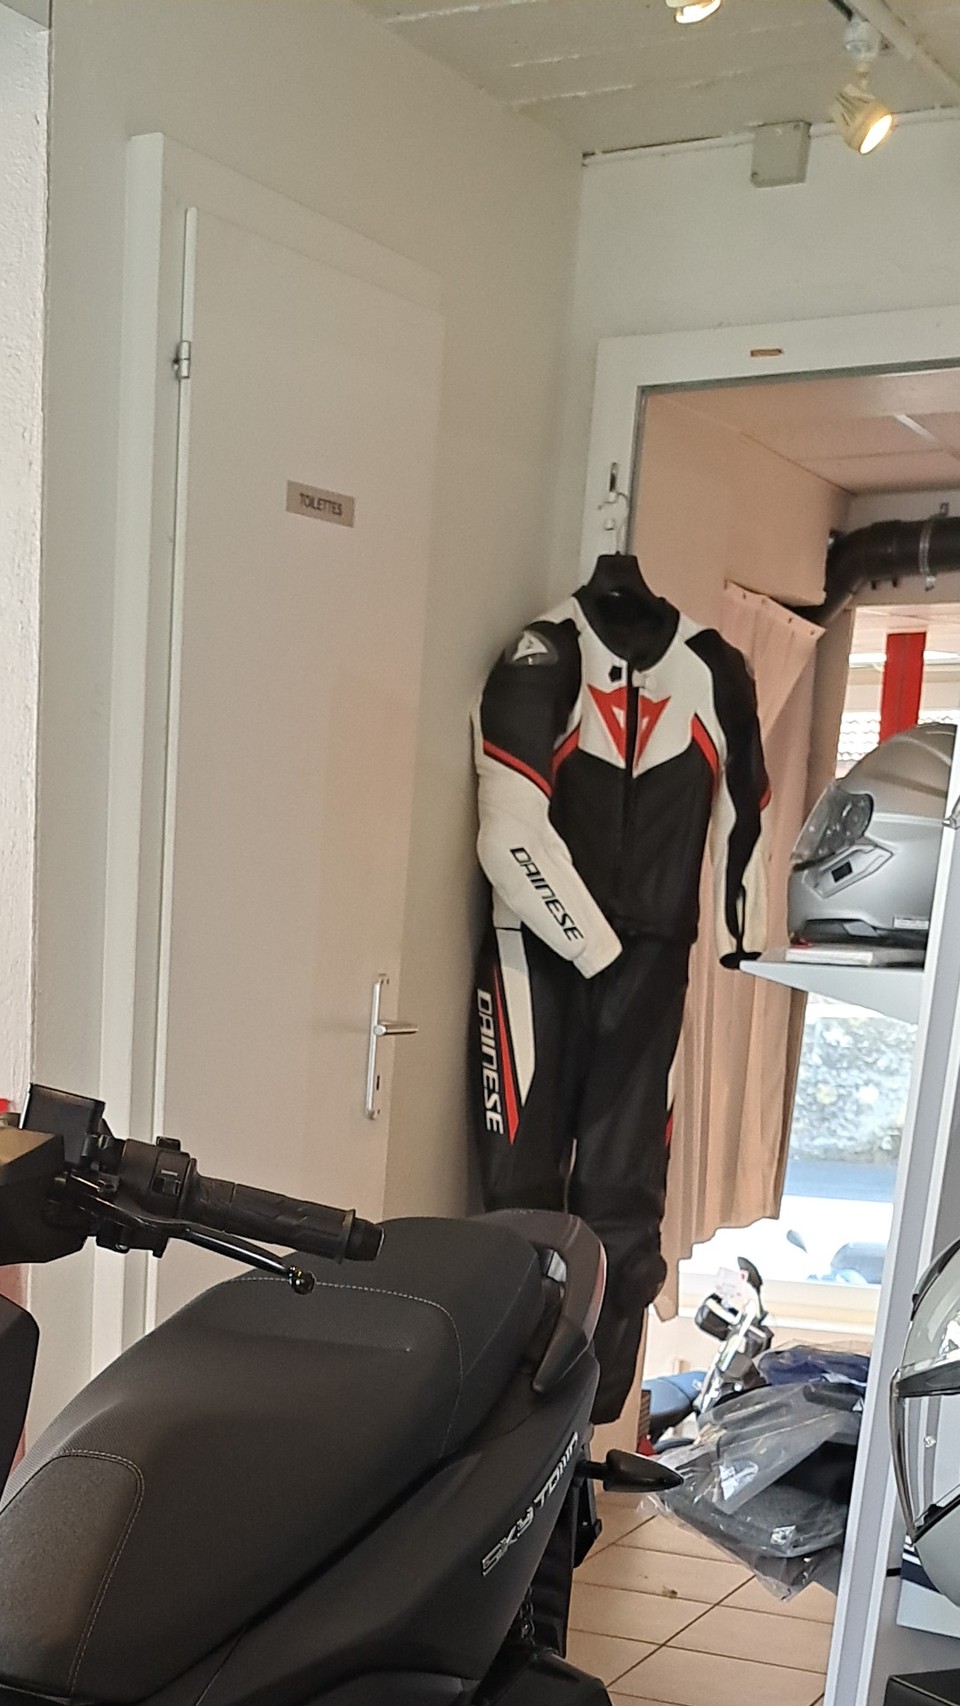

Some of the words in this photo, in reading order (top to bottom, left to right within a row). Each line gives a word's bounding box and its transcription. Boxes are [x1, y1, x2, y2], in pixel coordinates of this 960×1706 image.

[299, 492, 343, 516] TOILETTES
[509, 846, 584, 942] DAINESE
[477, 988, 504, 1135] DAINESE
